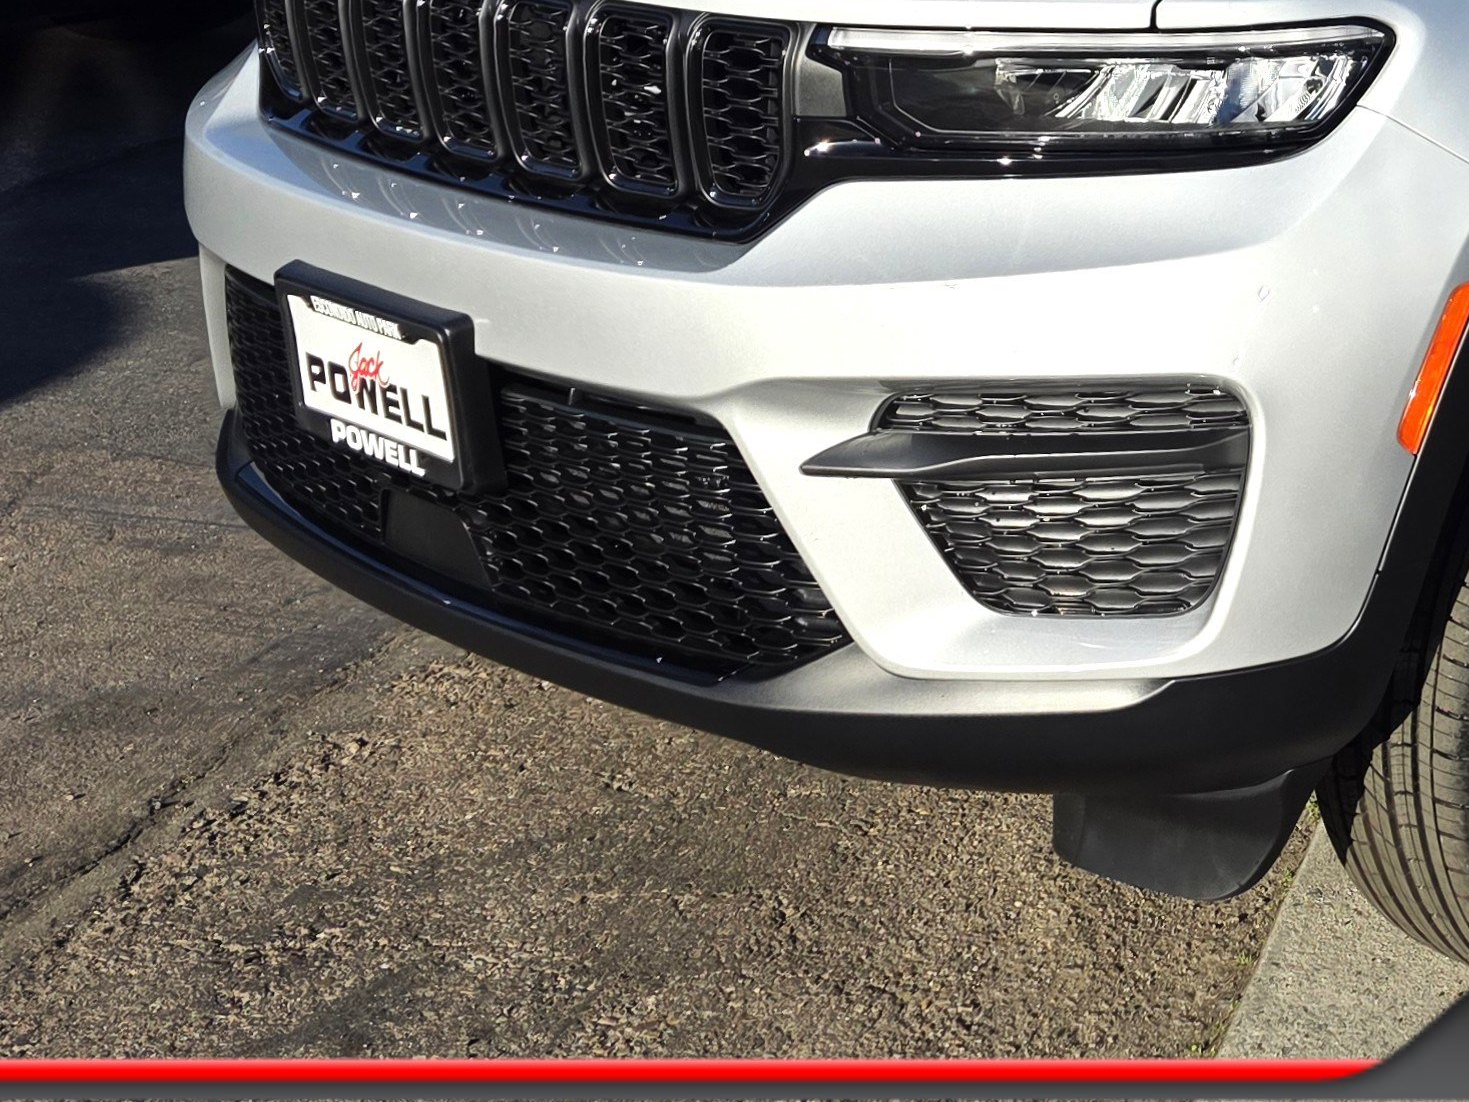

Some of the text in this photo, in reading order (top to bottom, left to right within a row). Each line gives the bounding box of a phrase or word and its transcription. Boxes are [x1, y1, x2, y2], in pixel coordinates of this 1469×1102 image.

[305, 351, 449, 441] POWELL
[348, 341, 390, 392] Jack
[330, 418, 426, 477] POWELL
